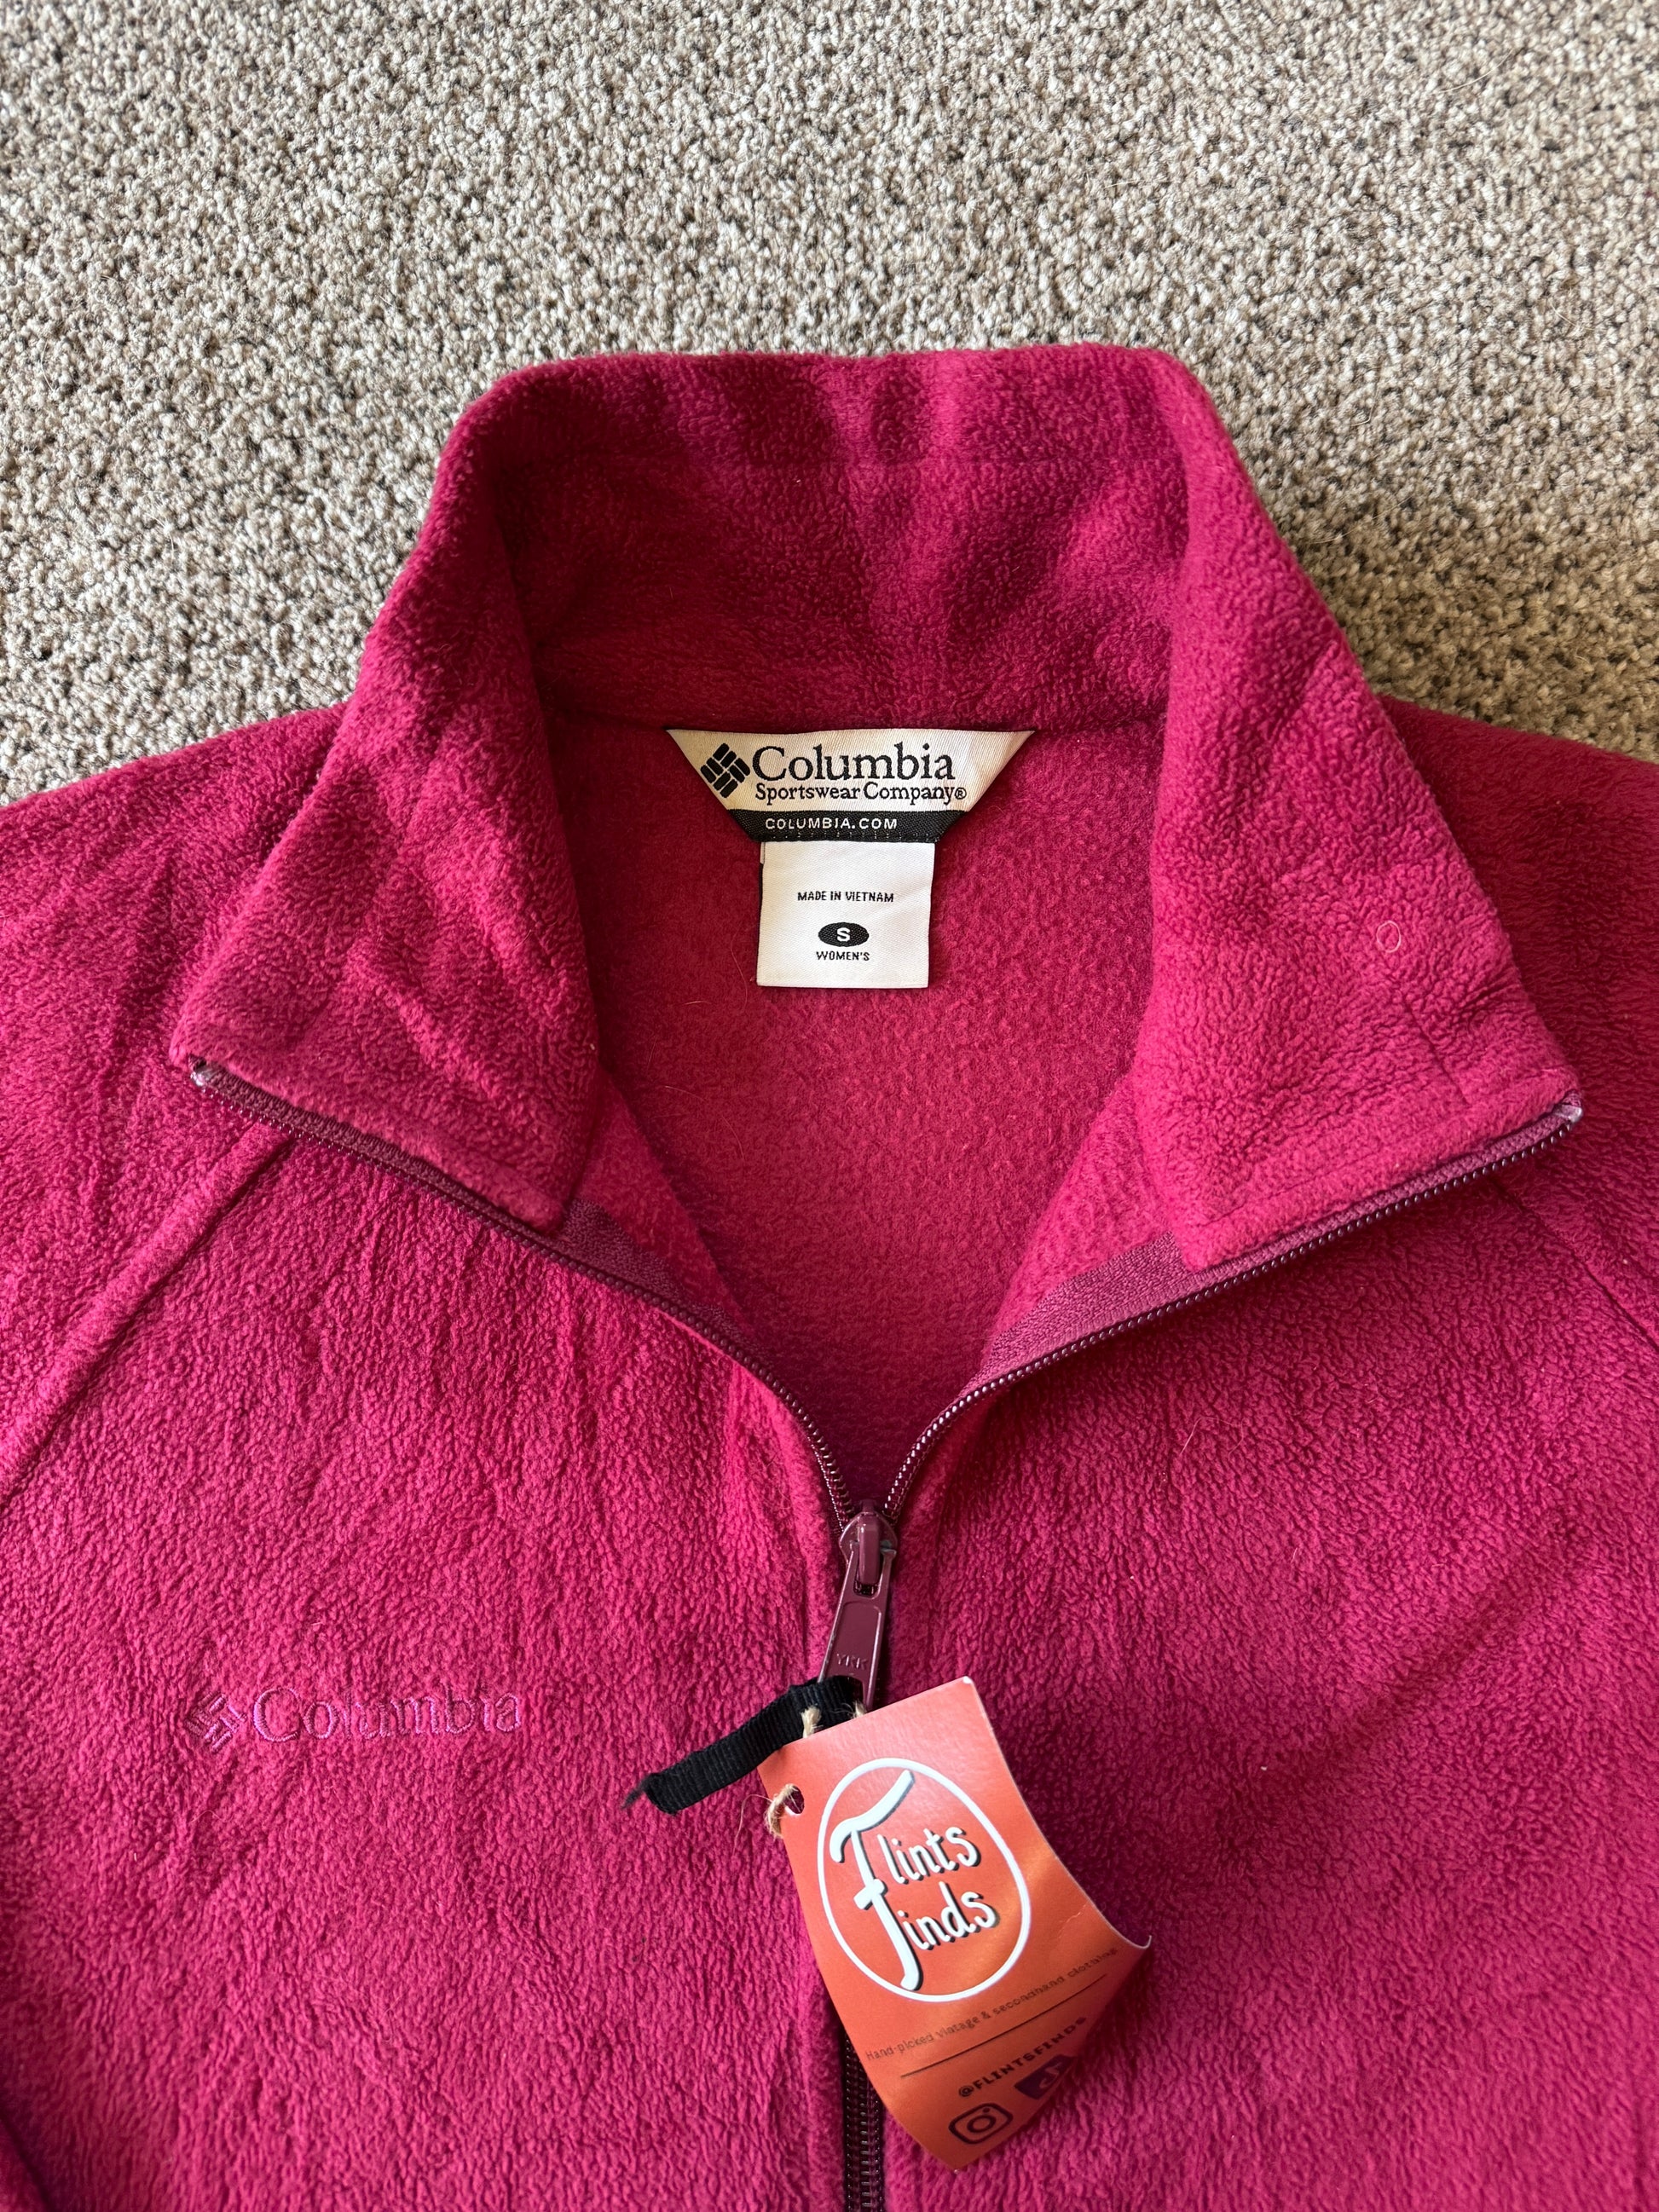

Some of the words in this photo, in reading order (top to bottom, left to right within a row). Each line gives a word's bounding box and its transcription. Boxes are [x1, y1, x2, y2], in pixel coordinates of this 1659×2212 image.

[752, 741, 956, 781] Columbia
[755, 782, 860, 806] Sportswear
[765, 817, 898, 830] COLUMBIA.COM
[797, 891, 827, 901] MADE
[830, 891, 841, 901] IN
[845, 892, 894, 903] VIETNAM
[836, 927, 851, 942] S
[816, 950, 870, 962] WOMEN'S
[253, 1684, 521, 1742] Columbia
[865, 2032, 935, 2061] Hand-picked
[935, 2015, 980, 2038] vintage
[980, 2011, 991, 2020] &
[992, 1975, 1065, 2015] secondhand
